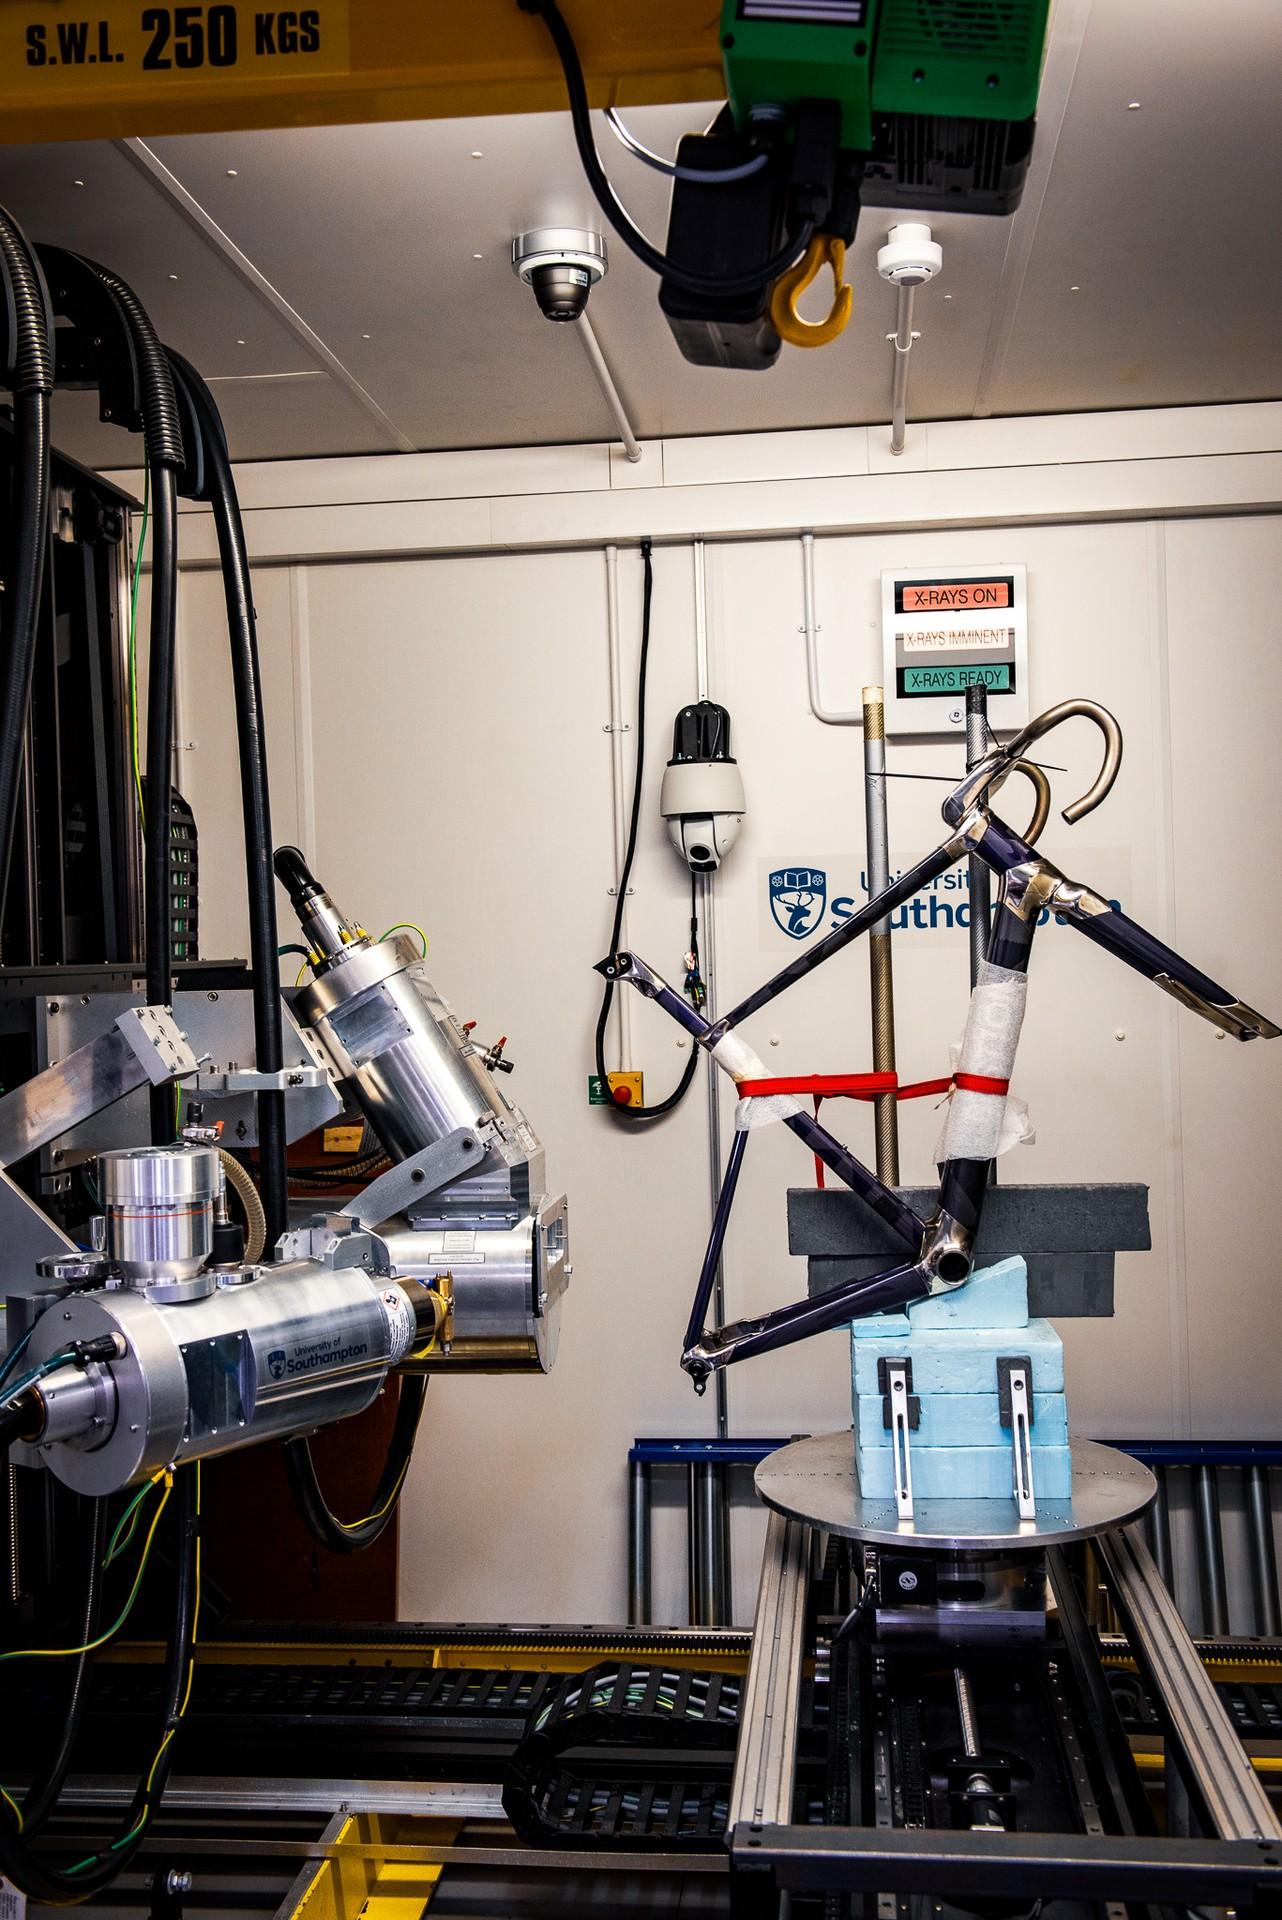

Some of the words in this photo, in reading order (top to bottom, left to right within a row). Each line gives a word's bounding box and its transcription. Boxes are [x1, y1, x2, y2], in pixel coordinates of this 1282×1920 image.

[26, 20, 124, 66] S.W.L.
[141, 5, 237, 70] 250
[255, 10, 320, 55] KGS
[914, 589, 969, 606] X-RAYS
[973, 588, 997, 603] ON
[906, 631, 946, 647] X-RAYS
[949, 629, 1006, 645] IMMINENT
[911, 672, 956, 688] X-RAYS
[959, 670, 1002, 687] READY
[861, 869, 970, 891] Uirsit
[294, 1341, 332, 1357] University
[333, 1336, 342, 1346] of
[287, 1343, 368, 1373] Southampton
